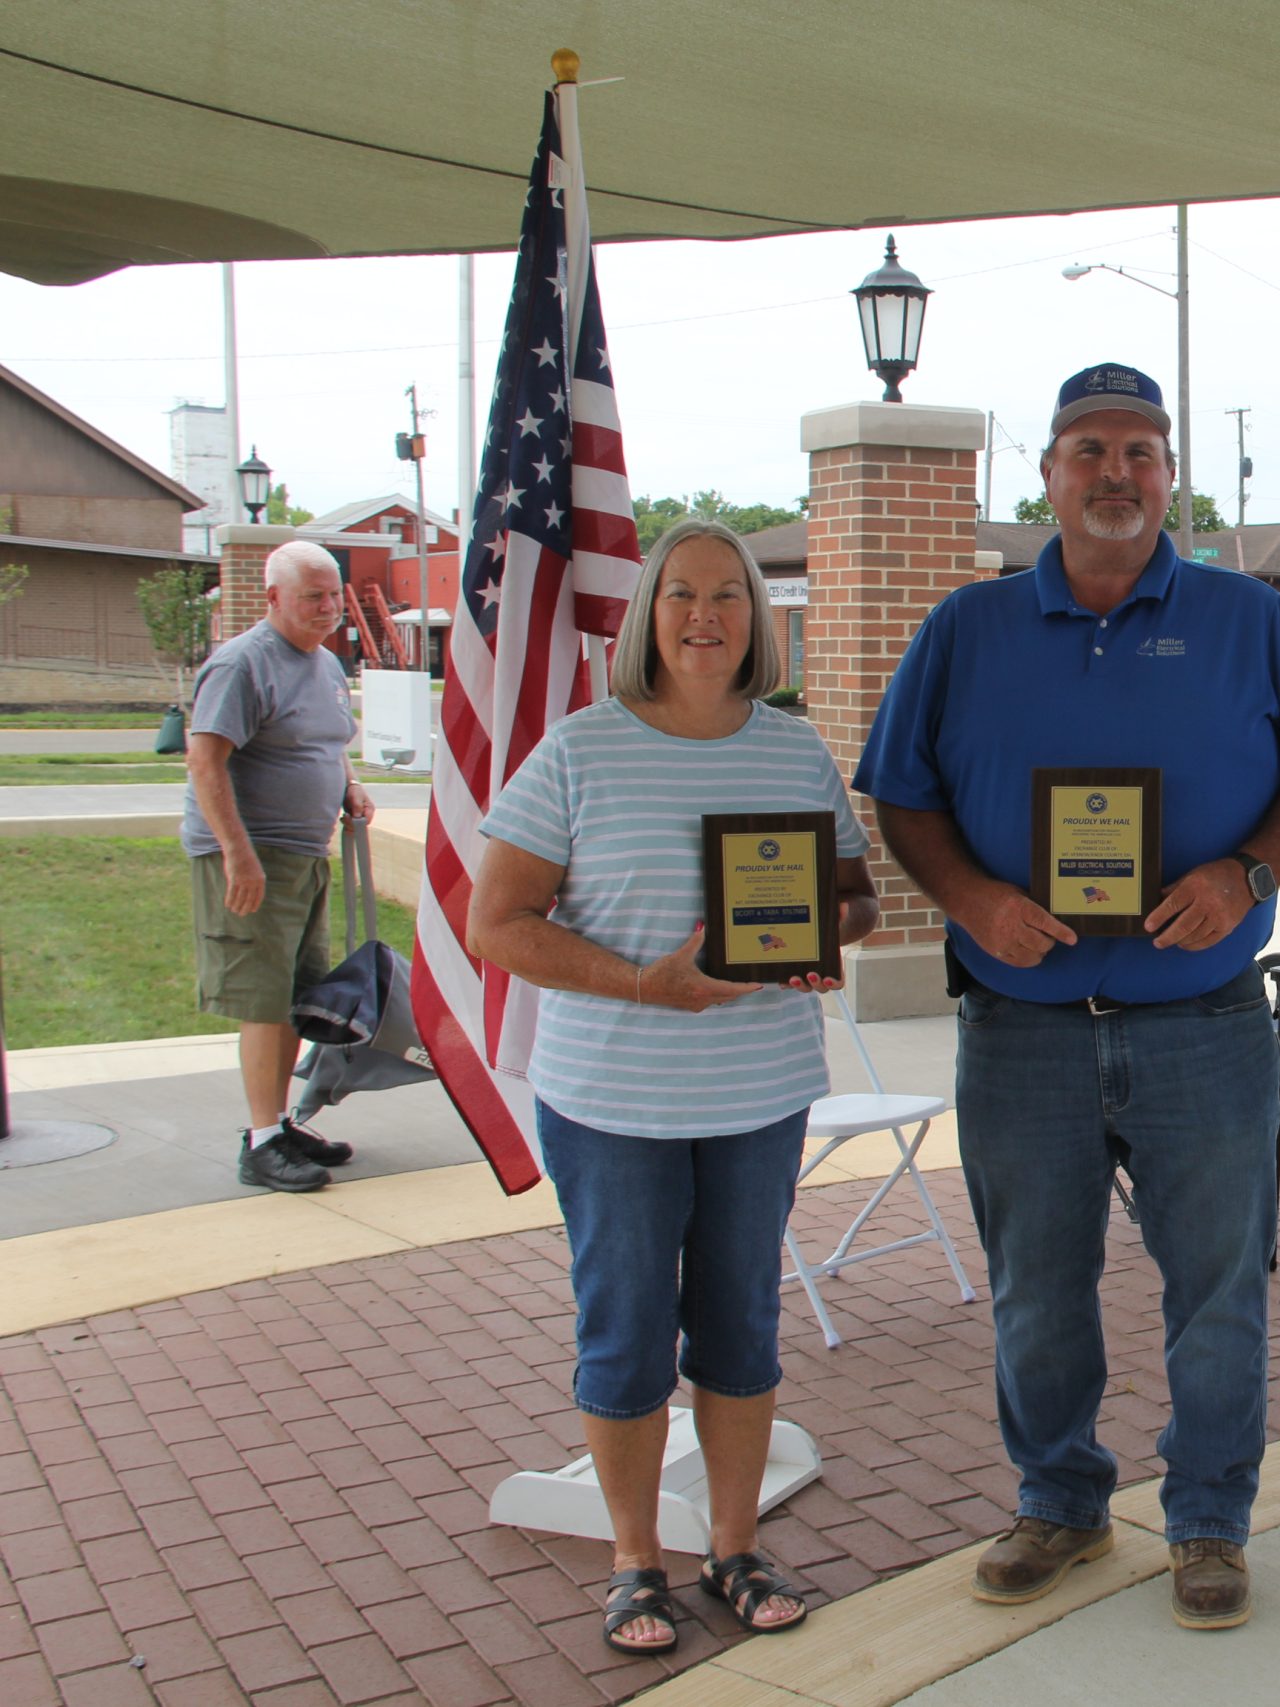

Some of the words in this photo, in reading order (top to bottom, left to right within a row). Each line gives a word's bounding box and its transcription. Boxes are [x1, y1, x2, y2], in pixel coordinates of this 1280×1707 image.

[1107, 370, 1136, 381] Miller
[769, 586, 779, 597] CES
[781, 586, 798, 597] Credit
